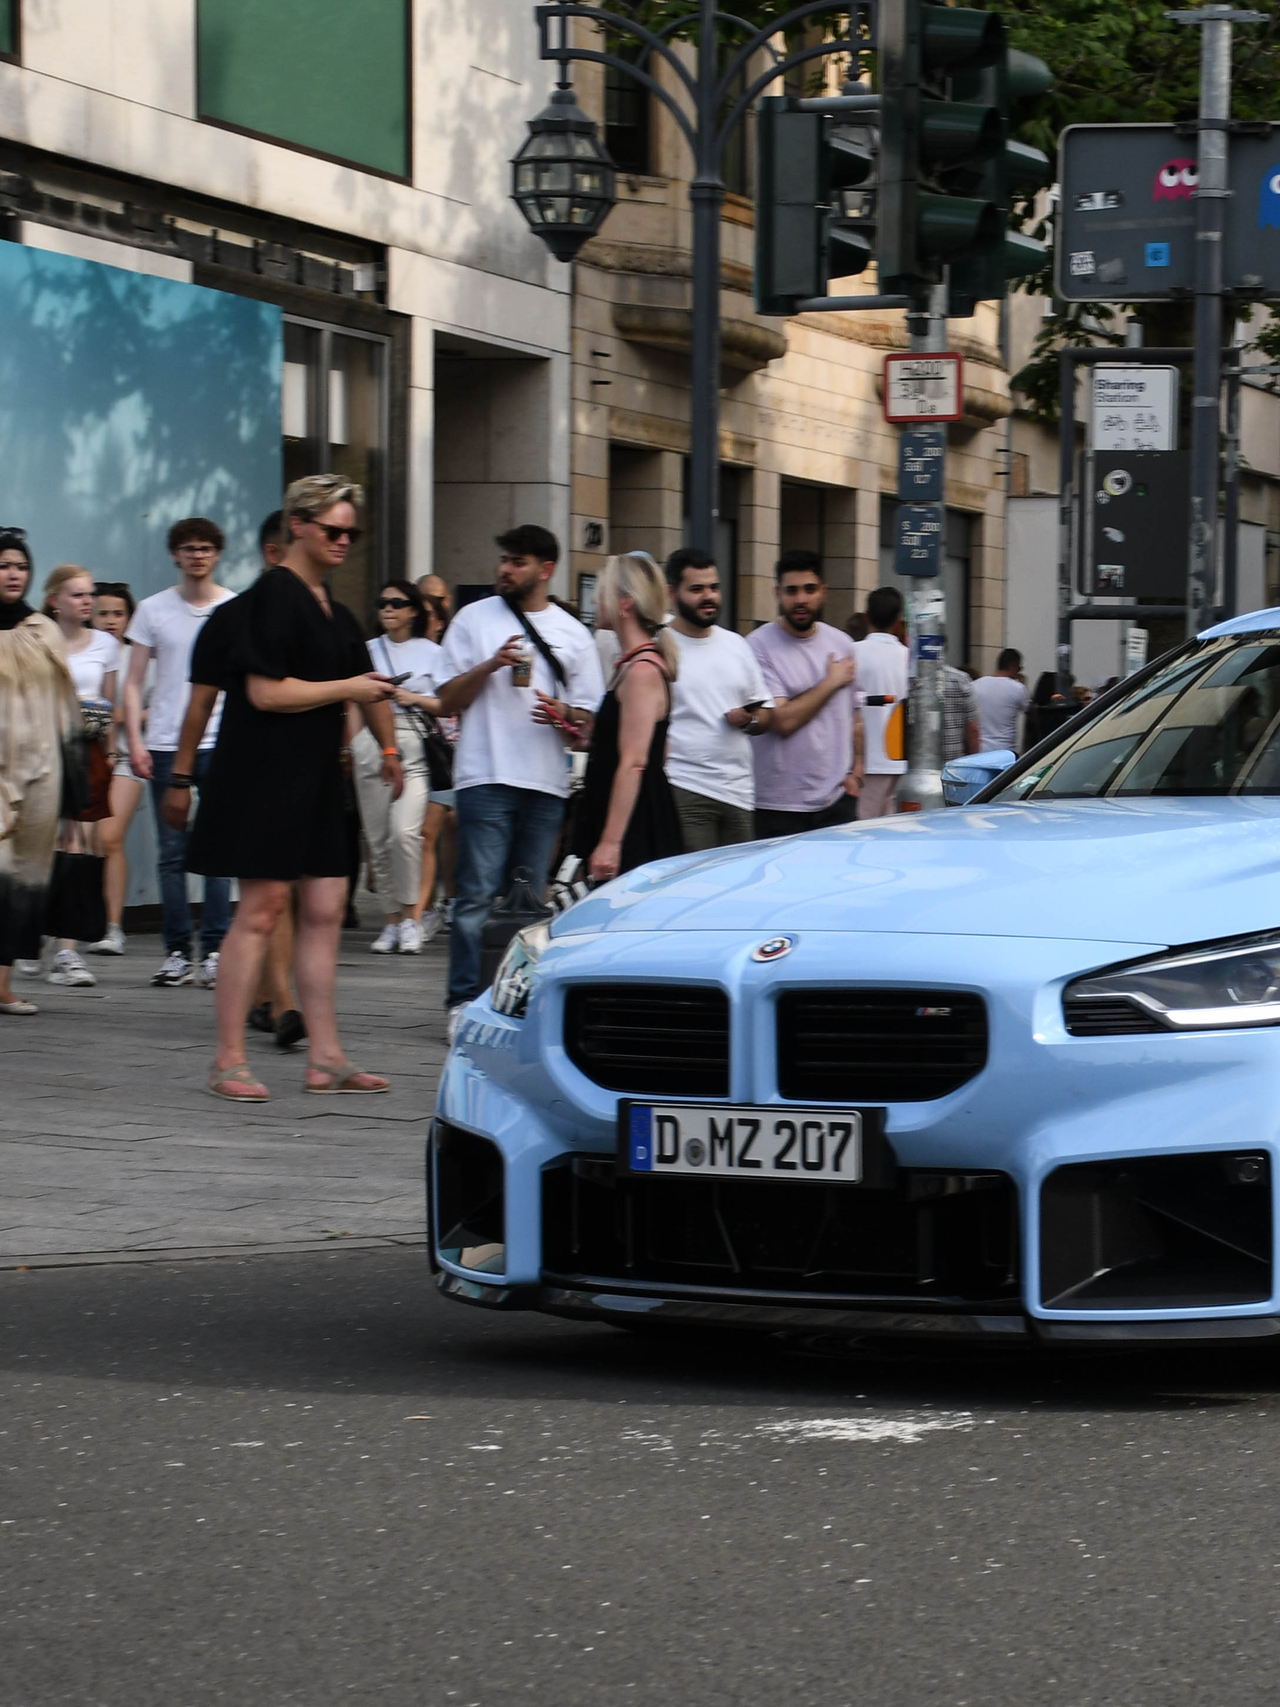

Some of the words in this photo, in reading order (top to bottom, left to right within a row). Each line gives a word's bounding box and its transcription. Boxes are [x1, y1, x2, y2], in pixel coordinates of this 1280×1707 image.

[1094, 379, 1146, 392] Sharing
[1094, 391, 1139, 402] Station
[655, 1114, 679, 1164] D
[709, 1116, 762, 1168] MZ
[773, 1119, 853, 1172] 207
